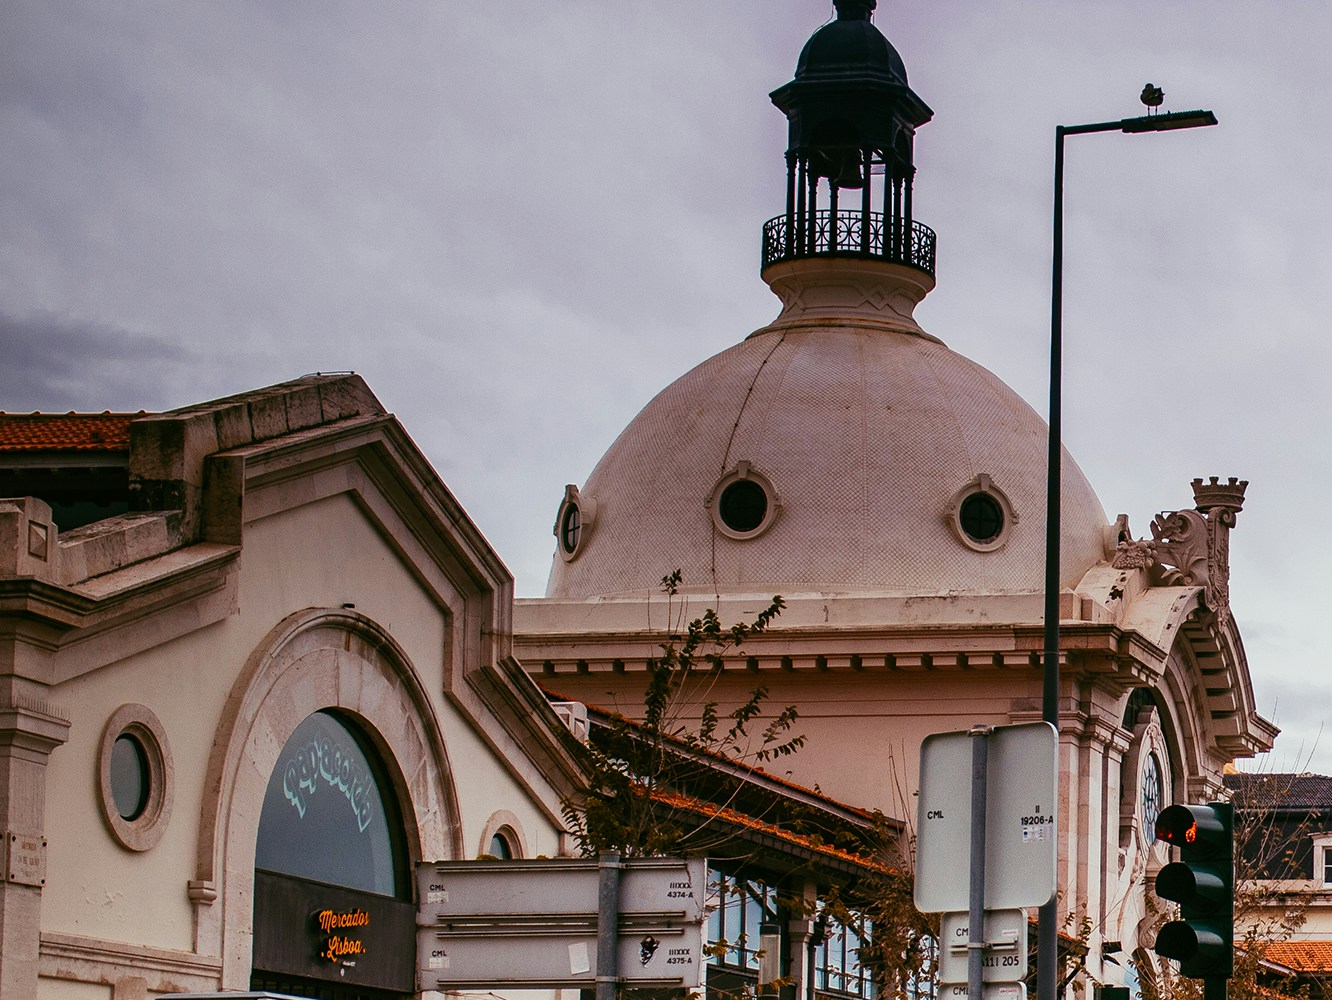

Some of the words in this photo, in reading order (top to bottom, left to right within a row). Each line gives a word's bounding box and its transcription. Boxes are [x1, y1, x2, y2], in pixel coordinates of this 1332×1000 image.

[927, 811, 944, 819] CML
[1021, 815, 1054, 825] 19206-A
[319, 908, 369, 934] Mercados
[1002, 956, 1019, 967] 205
